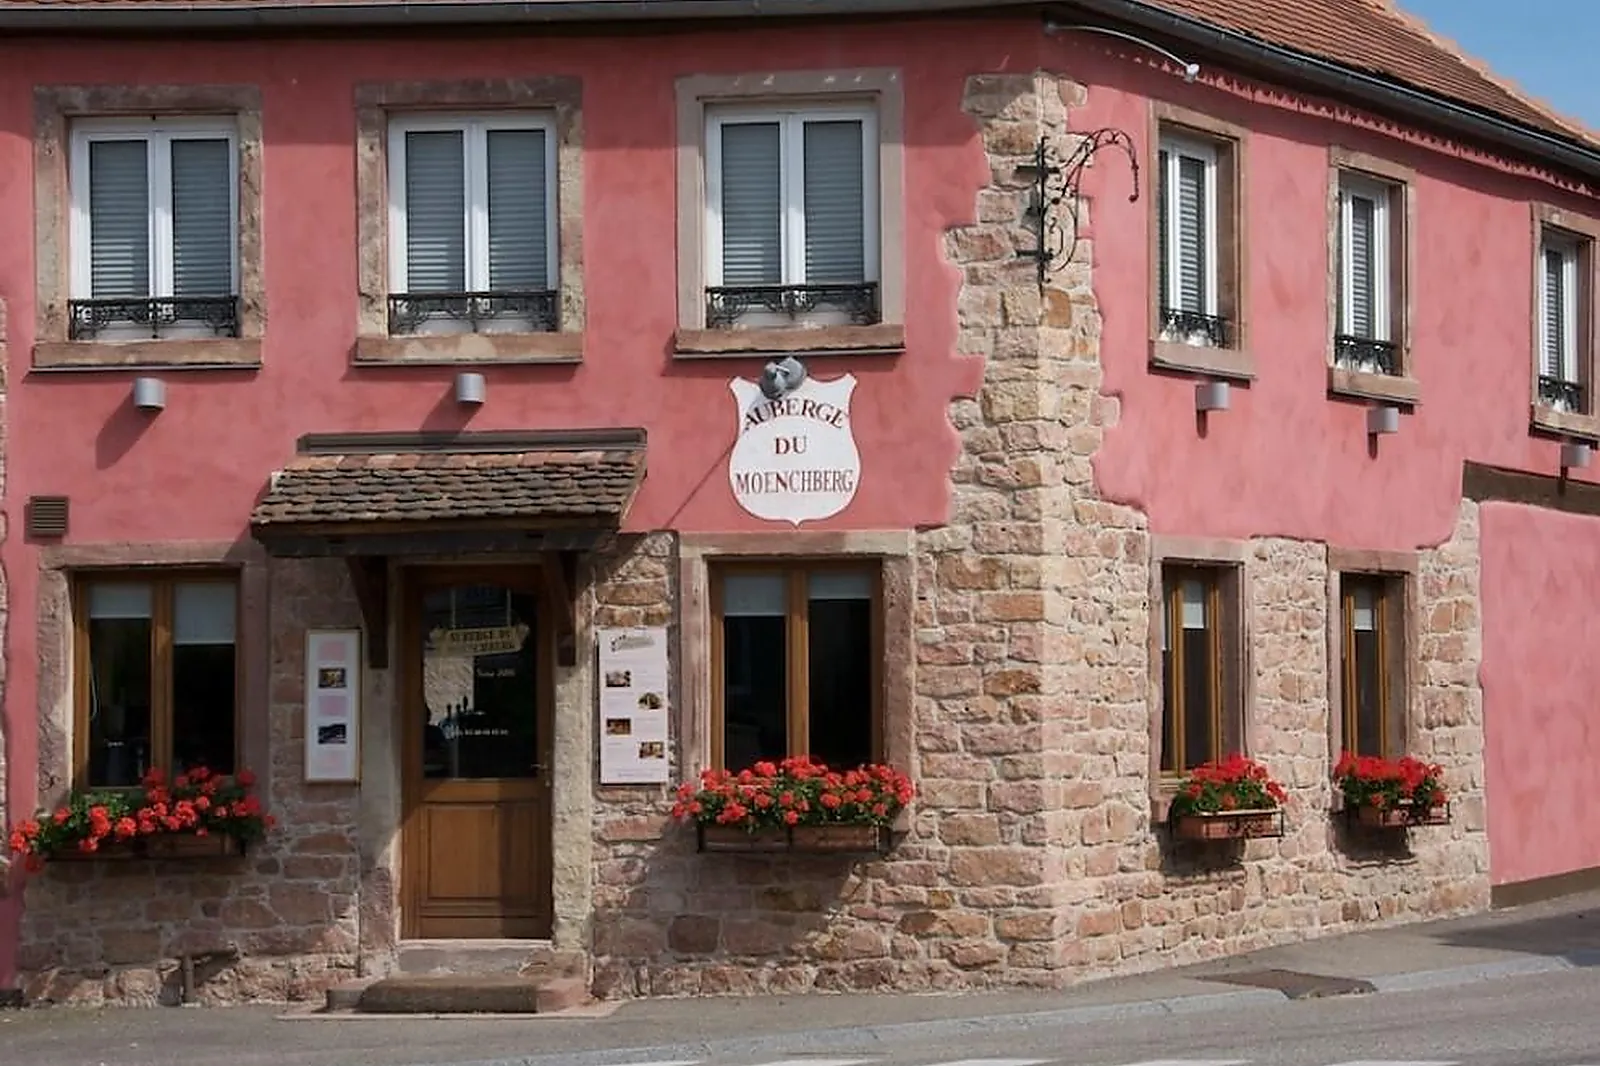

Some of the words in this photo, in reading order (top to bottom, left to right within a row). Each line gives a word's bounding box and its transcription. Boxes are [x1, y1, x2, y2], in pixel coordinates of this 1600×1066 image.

[744, 399, 847, 431] AUBERGE
[775, 436, 807, 455] DU
[736, 469, 854, 495] MOENCHBERG
